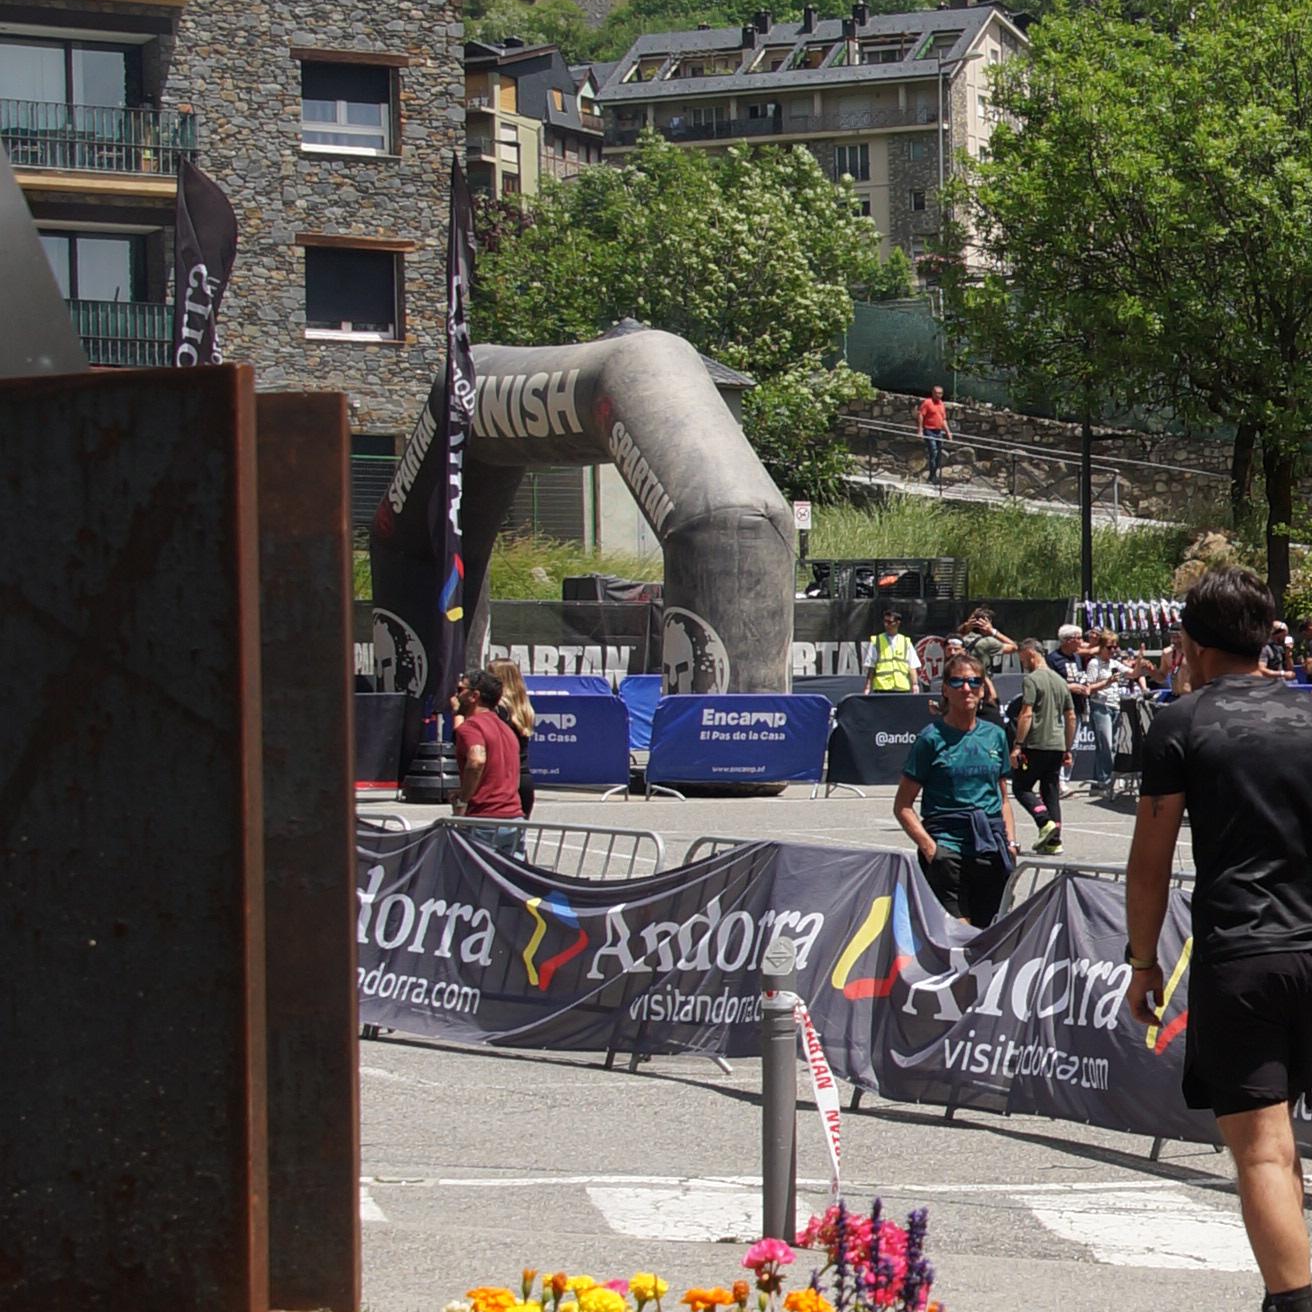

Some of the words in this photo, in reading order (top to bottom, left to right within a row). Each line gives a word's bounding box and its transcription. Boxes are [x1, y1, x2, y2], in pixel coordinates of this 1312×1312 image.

[472, 369, 583, 438] INISH
[389, 402, 437, 514] SPARTAN
[609, 421, 674, 531] SPARTAN
[547, 732, 577, 743] Casa
[700, 731, 710, 741] El
[712, 731, 730, 741] Pas
[733, 731, 747, 741] de
[749, 731, 758, 741] la
[760, 731, 785, 741] Casa
[702, 709, 787, 728] Encamp
[357, 864, 496, 967] dorra
[586, 895, 824, 979] Andorra
[902, 923, 1133, 1030] Andorra
